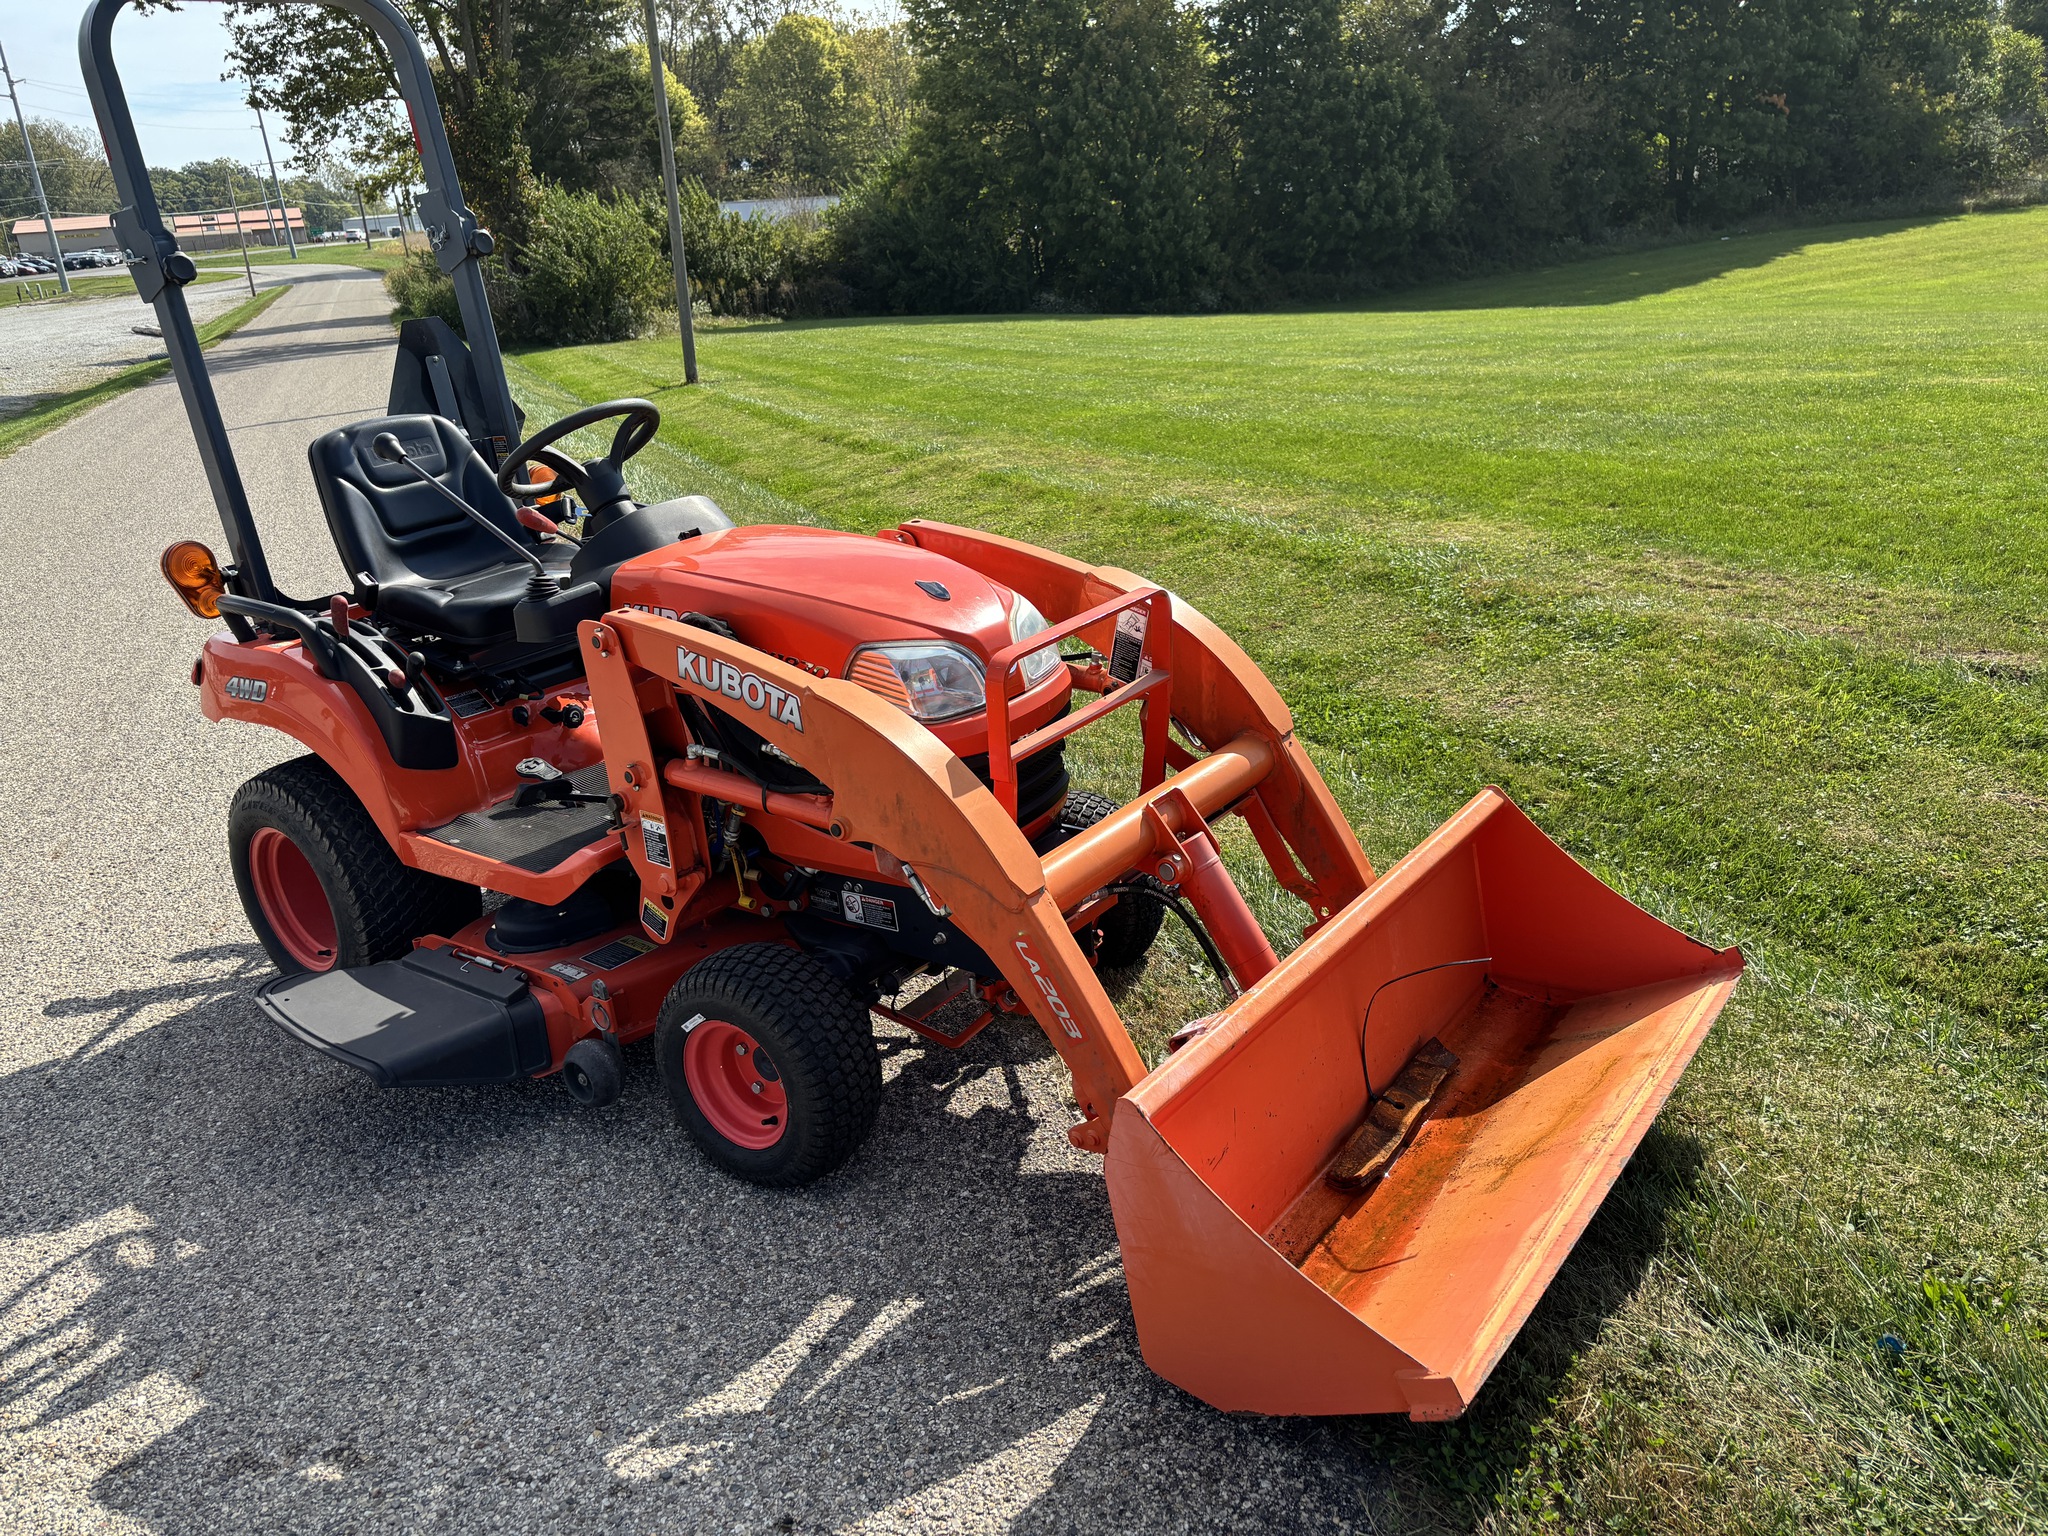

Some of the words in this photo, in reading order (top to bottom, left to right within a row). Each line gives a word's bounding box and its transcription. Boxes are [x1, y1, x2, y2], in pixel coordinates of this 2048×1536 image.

[225, 676, 268, 702] 4WD
[676, 645, 804, 734] KUBOTA
[1015, 941, 1083, 1039] LA203
